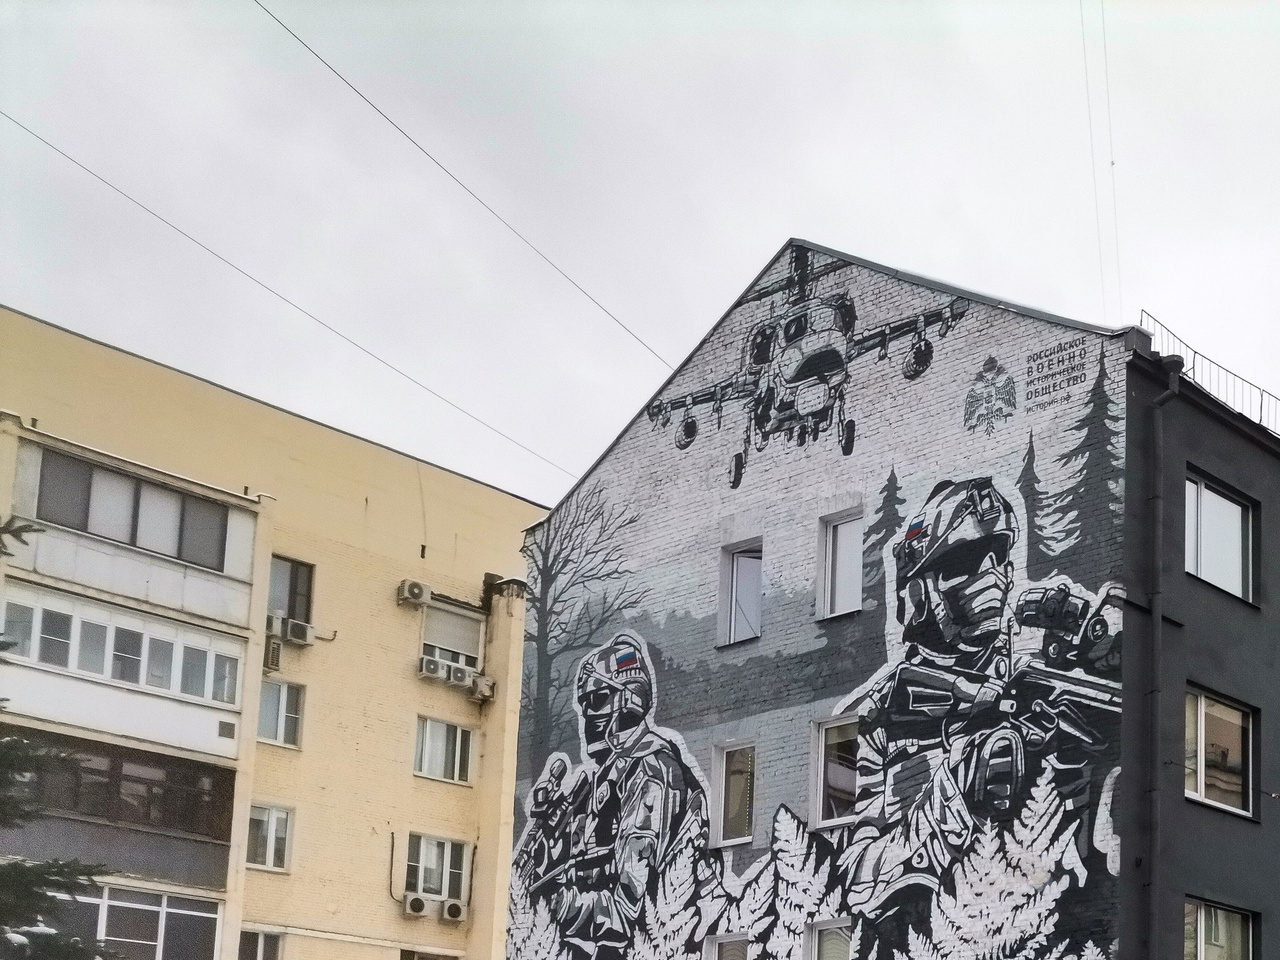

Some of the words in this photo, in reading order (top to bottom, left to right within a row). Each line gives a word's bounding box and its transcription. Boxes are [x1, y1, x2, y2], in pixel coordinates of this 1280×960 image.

[1027, 336, 1087, 364] РОССИЙСКОЕ
[1027, 348, 1087, 377] ВОЕННО
[1026, 362, 1087, 387] ИСТОРИЧЕСКОЕ
[1026, 372, 1087, 401] ОБЩЕСТВО
